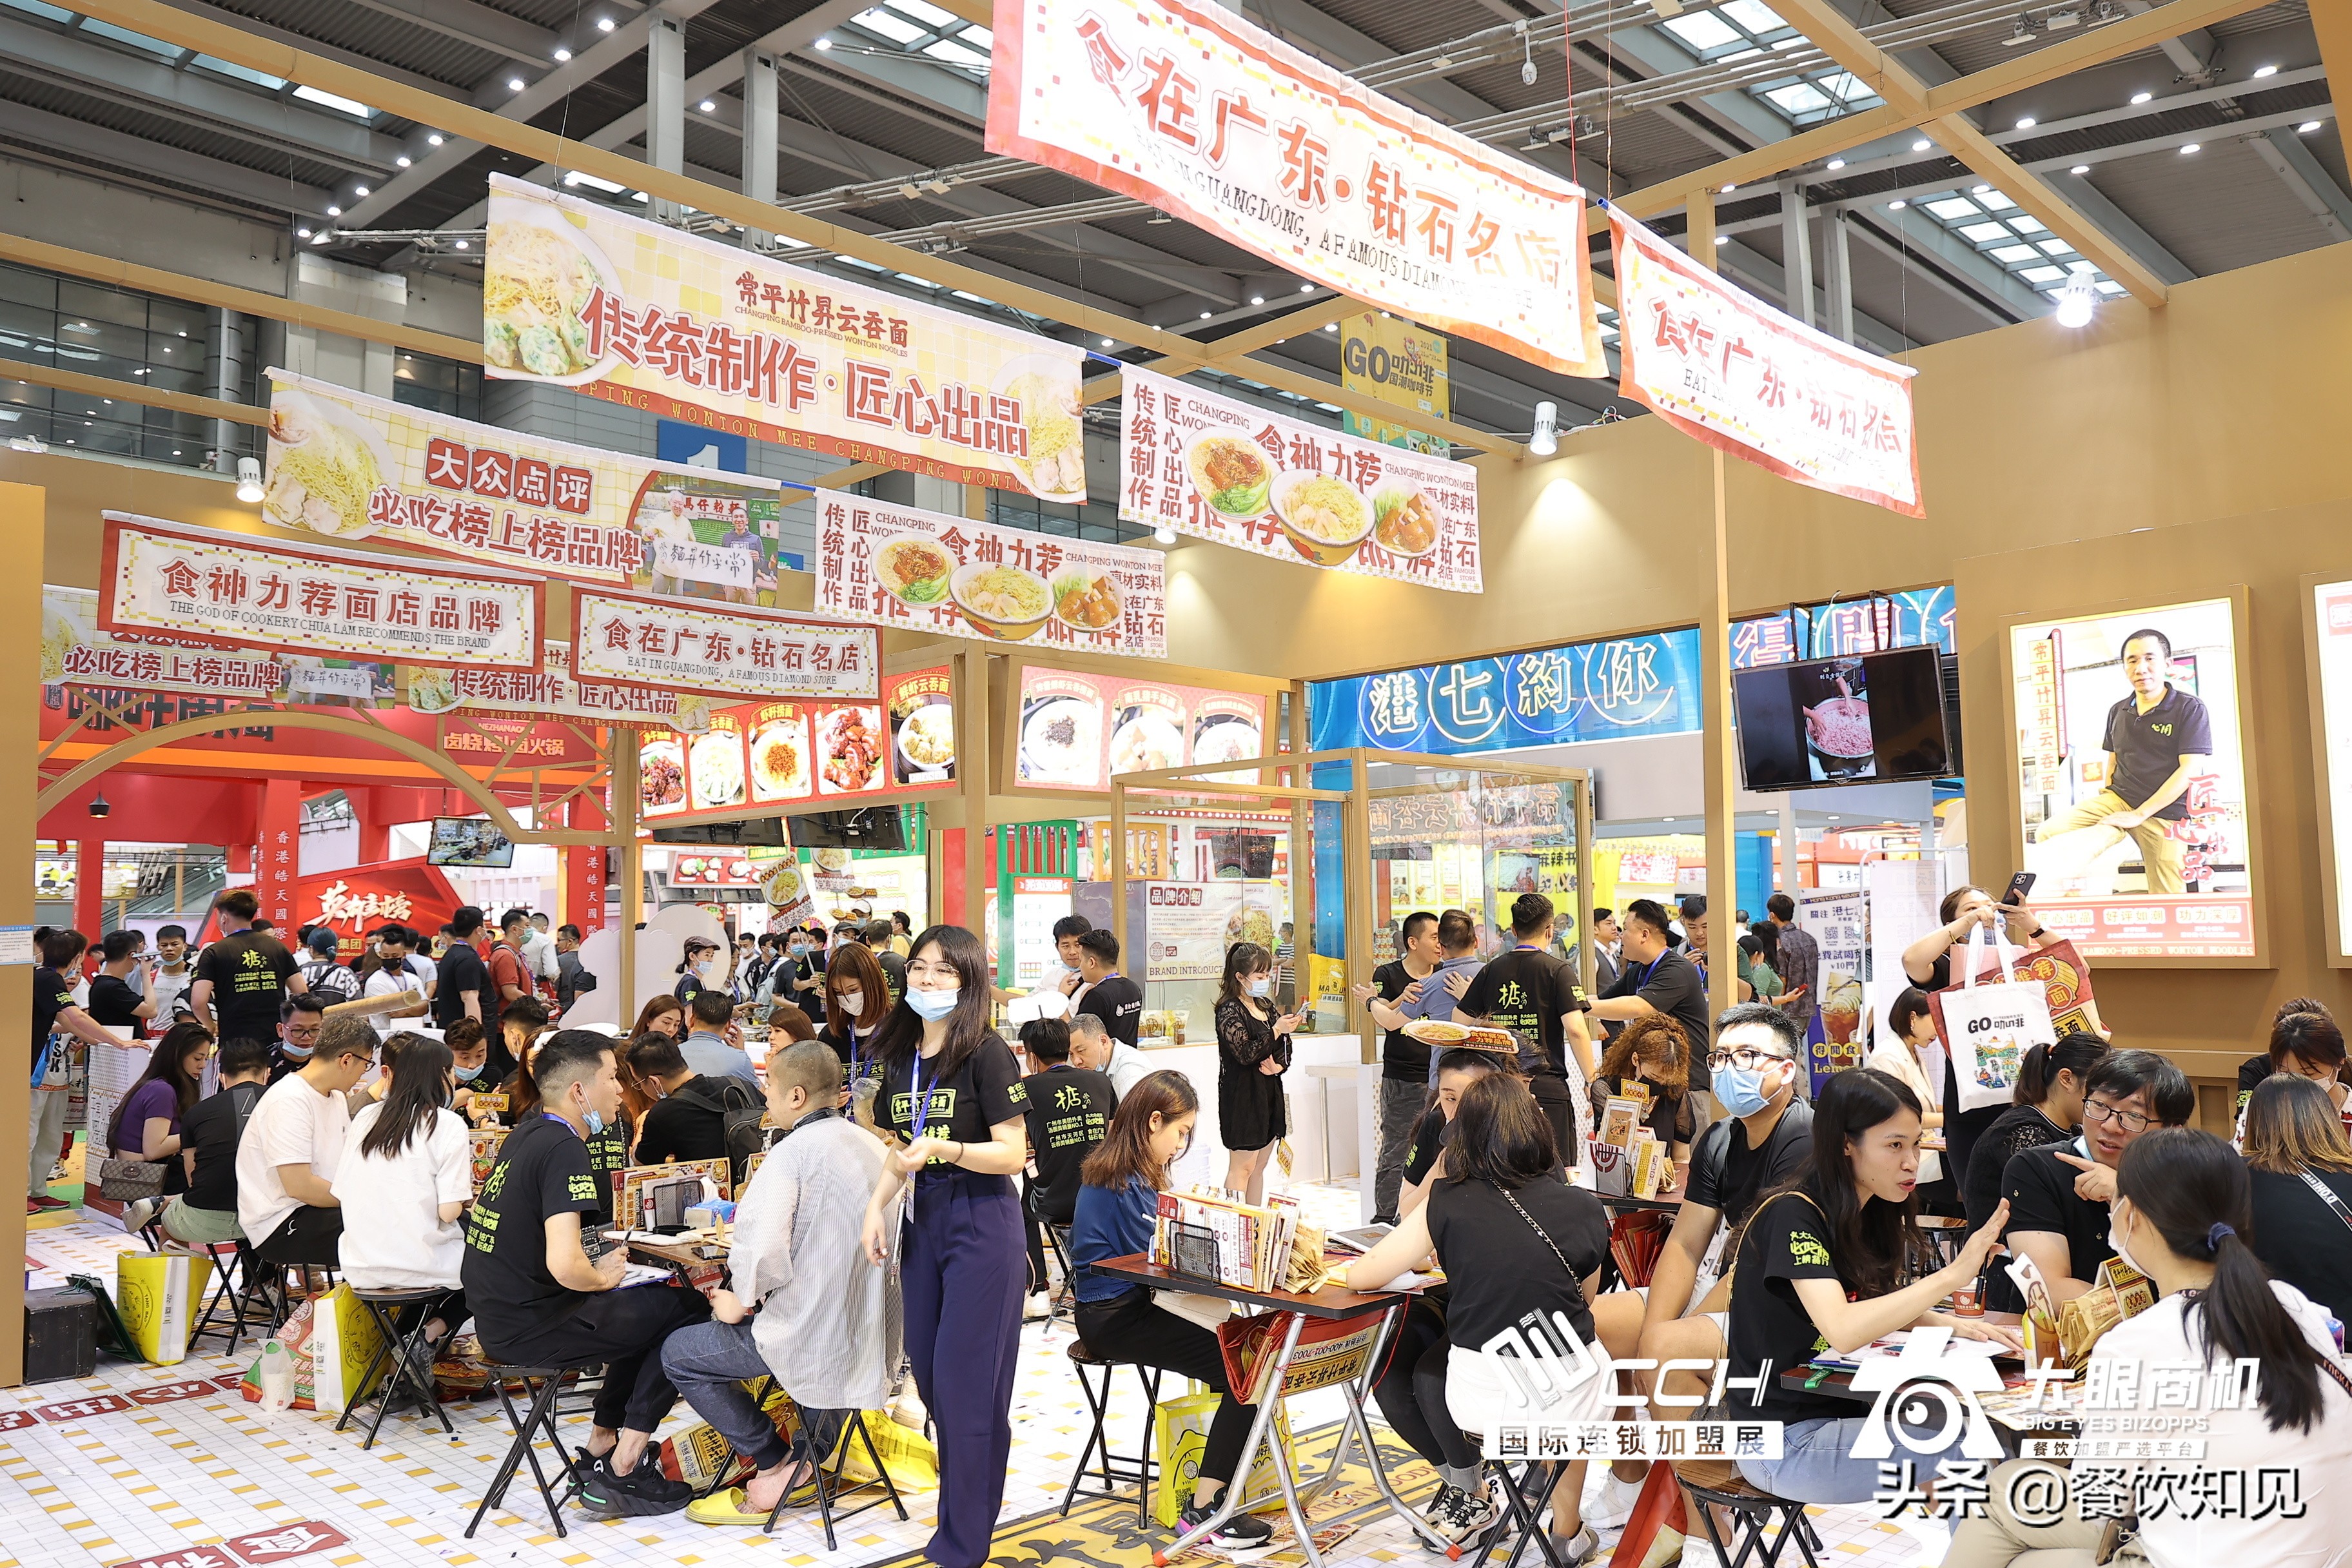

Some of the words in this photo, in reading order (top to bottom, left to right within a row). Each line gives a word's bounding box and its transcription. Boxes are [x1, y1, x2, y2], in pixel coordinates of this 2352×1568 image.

[1195, 171, 1310, 246] GUANGDONG,
[1334, 233, 1398, 277] FAMOUS
[736, 271, 908, 348] 常平竹昇云吞面
[734, 306, 781, 323] CHANGPING
[781, 318, 843, 341] BAMBOO-PRESSED
[845, 335, 882, 349] WONTON
[879, 342, 908, 358] NOODLES
[582, 286, 1028, 456] 传统制作·匠心出品
[1344, 337, 1391, 383] GO
[1389, 371, 1434, 397] 国潮咖啡节
[1188, 399, 1251, 430] CHANGPING
[671, 402, 758, 438] WONTON
[776, 429, 818, 451] MEE
[836, 441, 945, 478] CHANGPING
[1128, 382, 1158, 511] 传统制作
[1159, 392, 1184, 518] 匠心出品
[429, 444, 590, 514] 大众点评
[1385, 462, 1426, 482] CHANGPING
[1426, 473, 1460, 488] WONTON
[1459, 482, 1476, 492] MEE
[368, 489, 644, 573] 必吃榜上榜品牌
[876, 512, 936, 533] CHANGPING
[1442, 516, 1476, 538] 在广东
[823, 502, 845, 607] 传统制作
[850, 509, 871, 611] 匠心出品
[1066, 553, 1111, 566] CHANGPING
[1113, 558, 1146, 570] WONTON
[1148, 563, 1163, 572] MEE
[1440, 534, 1476, 568] 钻石
[1438, 564, 1453, 580] 名店
[163, 560, 501, 633] 食神力荐面店品牌
[170, 600, 195, 614] THE
[196, 605, 220, 619] GOD
[222, 609, 239, 621] OF
[241, 612, 299, 629] COOKERY
[300, 619, 331, 633] CHUA
[333, 623, 357, 636] LAM
[358, 626, 432, 644] RECOMMENDS
[434, 634, 455, 645] THE
[457, 636, 491, 649] BRAND
[1124, 610, 1164, 636] 钻石
[603, 617, 860, 672] 食在广东·钻石名店
[1124, 635, 1144, 648] 名店
[64, 646, 283, 691] 必吃榜上榜品牌
[627, 656, 647, 667] EAT
[649, 660, 662, 669] IN
[663, 662, 724, 678] GUANGDONG,
[728, 669, 735, 678] A
[736, 671, 770, 681] FAMOUS
[772, 673, 812, 684] DIAMOND
[814, 675, 838, 685] STORE
[449, 670, 678, 716] 传统制作·匠心出品
[447, 708, 480, 718] PING
[490, 710, 536, 721] WONTON
[545, 714, 565, 723] MEE
[573, 716, 635, 730] CHANGPING
[2033, 641, 2056, 791] 常平竹昇云吞面
[1150, 887, 1202, 906] 品牌介绍
[338, 938, 362, 950] 集团
[2082, 946, 2162, 956] BAMBOO-PRESSED
[2167, 946, 2204, 956] WONTON
[2208, 945, 2253, 956] NOODLES
[1150, 966, 1177, 976] BRAND
[1968, 1017, 1992, 1034] GO
[1046, 1115, 1083, 1128] 广州市美团外卖
[1050, 1130, 1084, 1143] 广州市天河区
